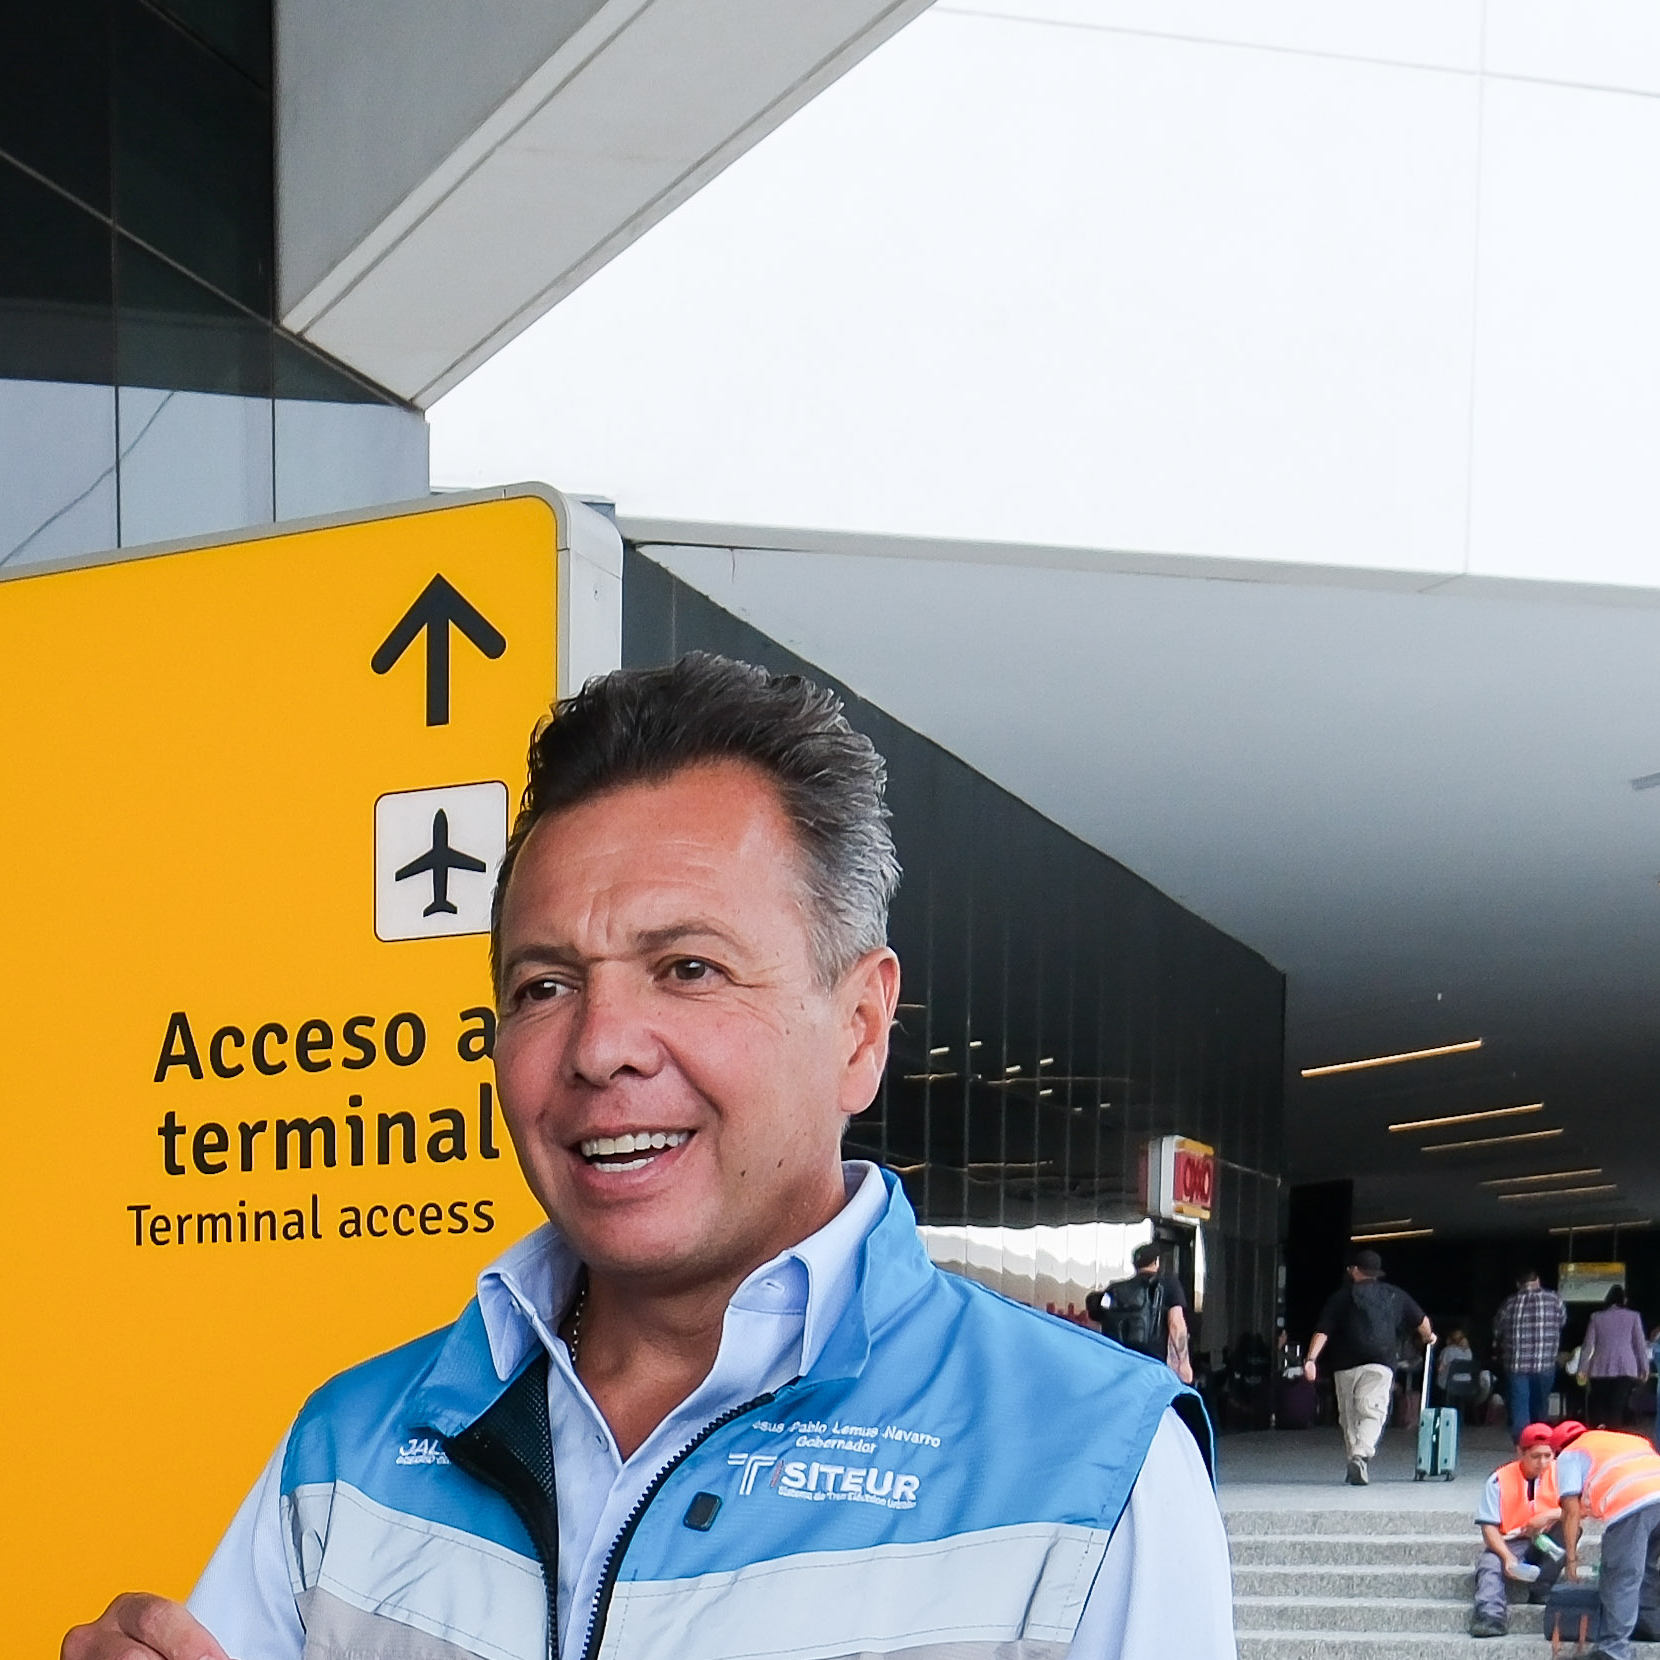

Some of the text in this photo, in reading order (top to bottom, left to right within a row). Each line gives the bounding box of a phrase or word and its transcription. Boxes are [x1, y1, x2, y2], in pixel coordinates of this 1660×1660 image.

[154, 1005, 497, 1083] Acceso a
[157, 1082, 500, 1176] terminal
[126, 1194, 495, 1247] Terminal access
[795, 1435, 877, 1454] Gobernador
[831, 1420, 879, 1438] Lemus
[882, 1425, 941, 1448] Navarro
[780, 1461, 920, 1502] SITEUR
